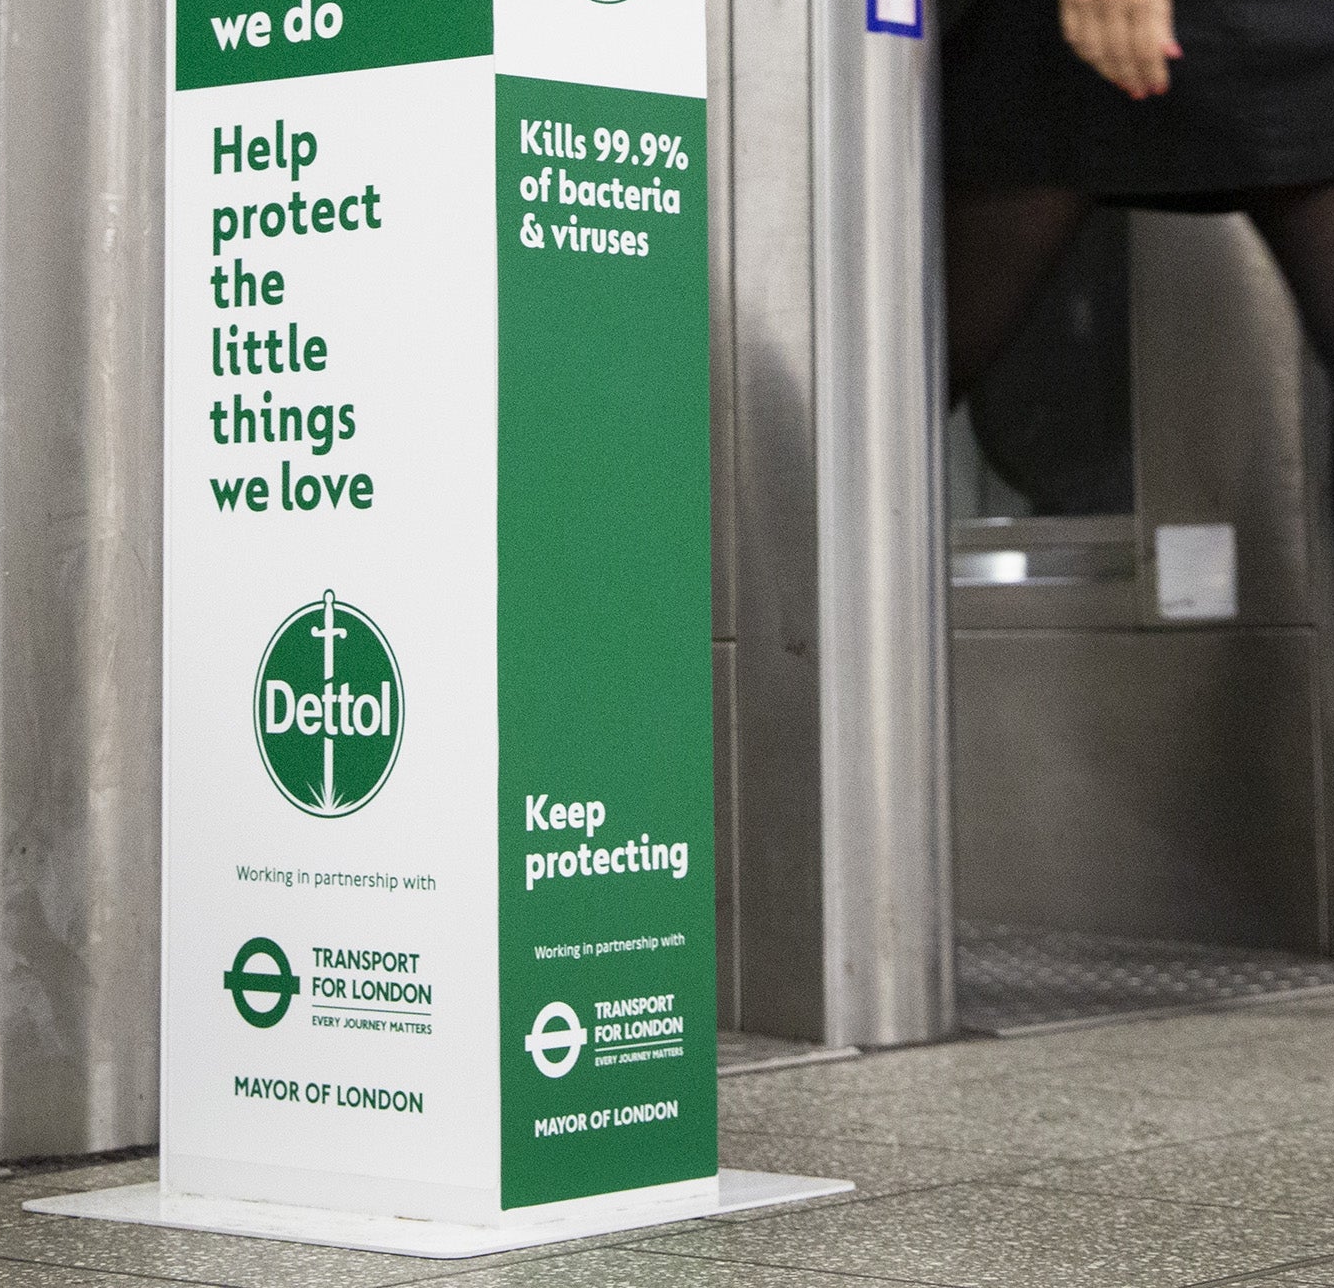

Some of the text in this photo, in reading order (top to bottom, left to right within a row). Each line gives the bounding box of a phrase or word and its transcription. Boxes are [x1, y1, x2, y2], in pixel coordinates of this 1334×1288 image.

[211, 12, 271, 50] we
[214, 120, 317, 181] Help
[521, 120, 688, 170] Kills 99.9%
[520, 167, 680, 214] of bacteria
[213, 185, 381, 255] protect
[520, 213, 648, 256] & viruses
[211, 259, 284, 308] the
[213, 323, 327, 376] little
[210, 391, 355, 455] things
[210, 461, 373, 512] we love
[266, 680, 390, 736] Dettol
[526, 794, 605, 837] Keep
[236, 866, 436, 892] Working in partnership with
[526, 834, 688, 890] protecting
[313, 947, 419, 973] TRANSPORT
[535, 933, 685, 959] Working in partnership with
[313, 977, 431, 1004] FOR LONDON
[595, 994, 674, 1019] TRANSPORT
[312, 1015, 432, 1034] EVERY JOURNEY MATTERS
[595, 1017, 683, 1042] FOR LONDON
[595, 1047, 683, 1066] EVERY JOURNEY MATTERS
[235, 1076, 423, 1113] MAYOR OF LONDON
[535, 1100, 678, 1137] MAYOR OF LONDON
